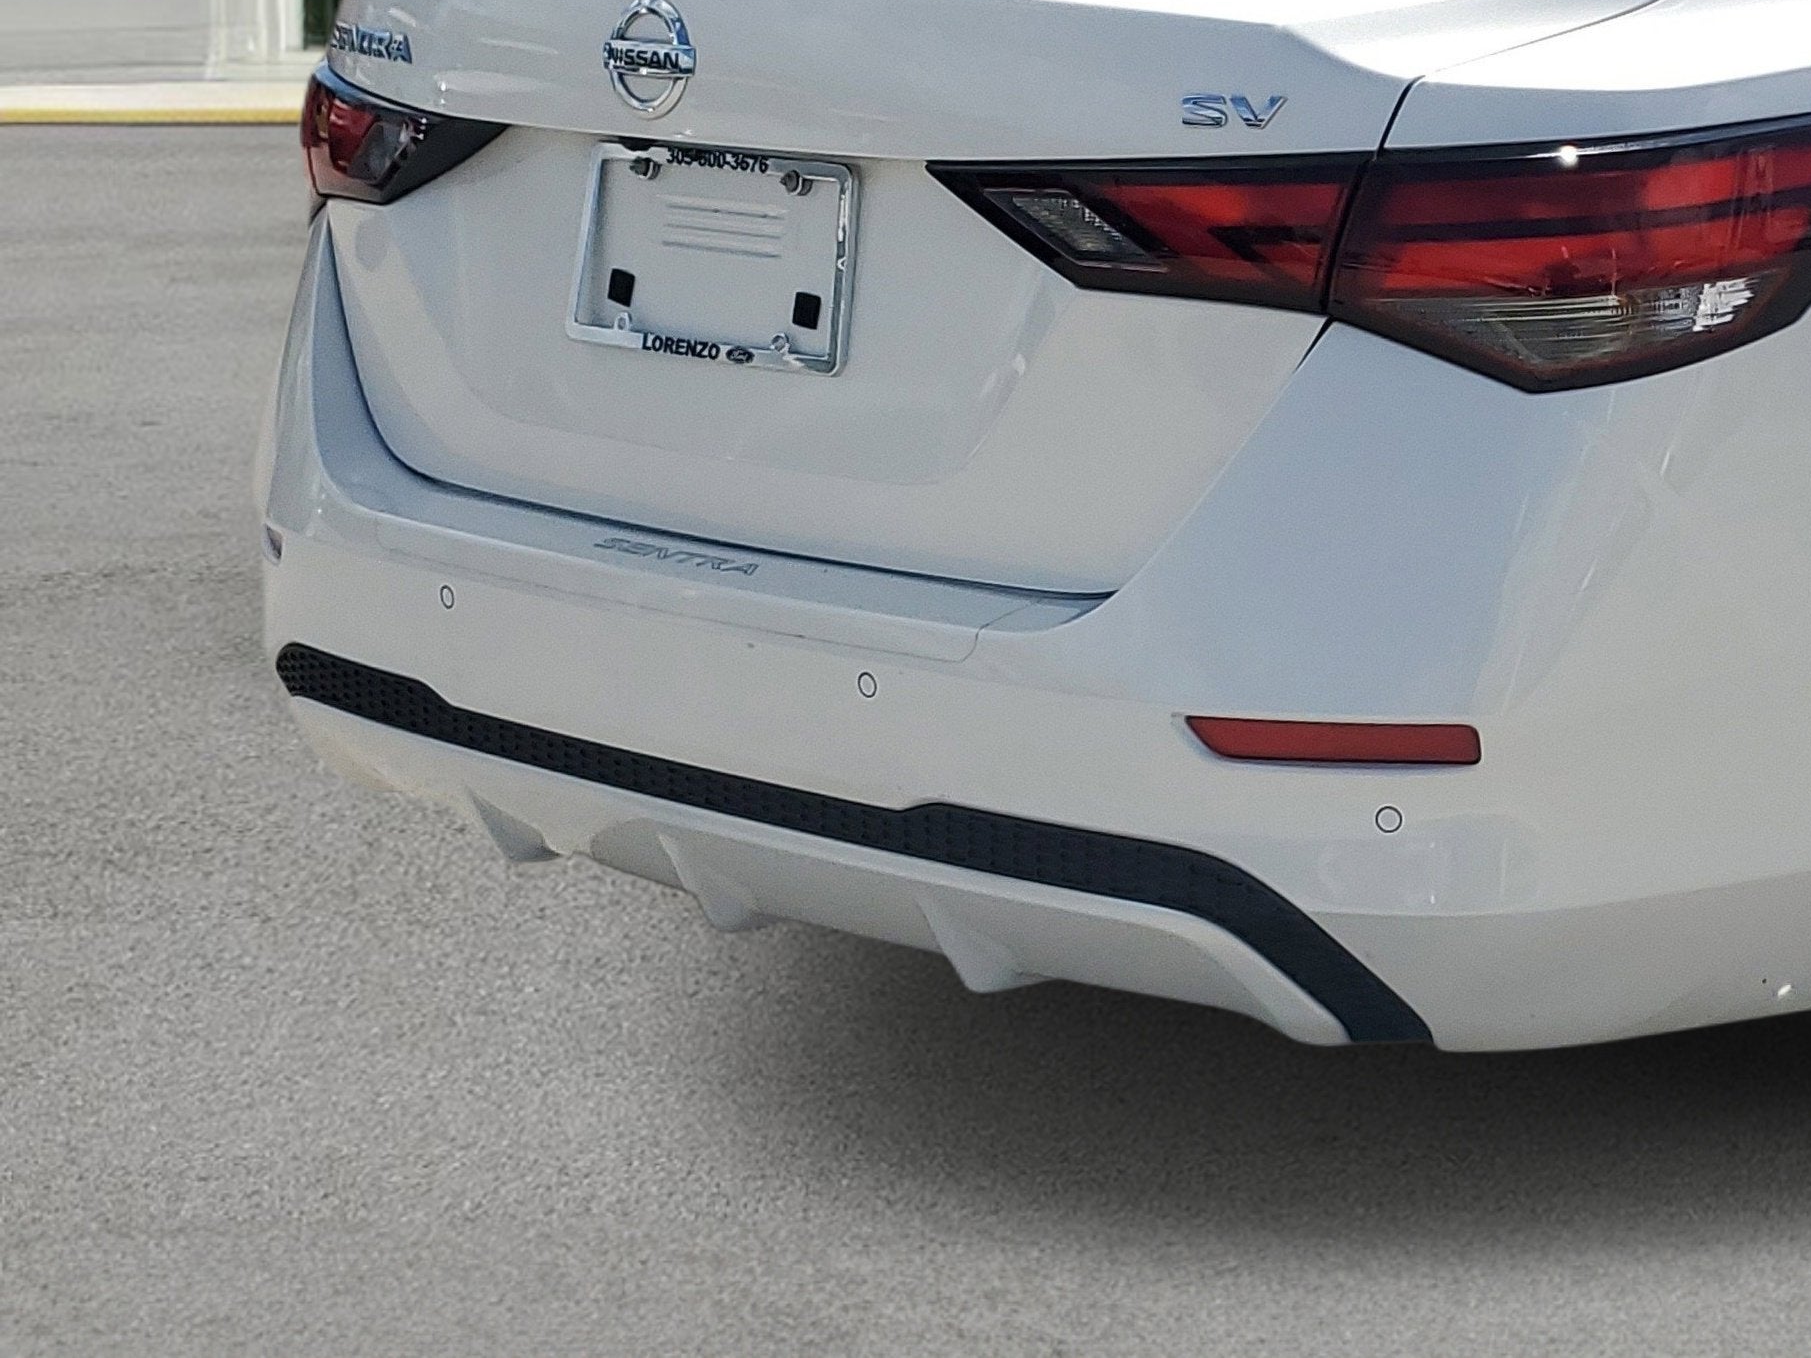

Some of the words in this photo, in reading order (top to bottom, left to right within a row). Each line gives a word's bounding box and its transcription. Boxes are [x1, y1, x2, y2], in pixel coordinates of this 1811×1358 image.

[608, 46, 680, 70] NISSAN
[1181, 93, 1288, 130] SV
[642, 332, 721, 360] LORENZO
[594, 538, 759, 576] SENTRA
